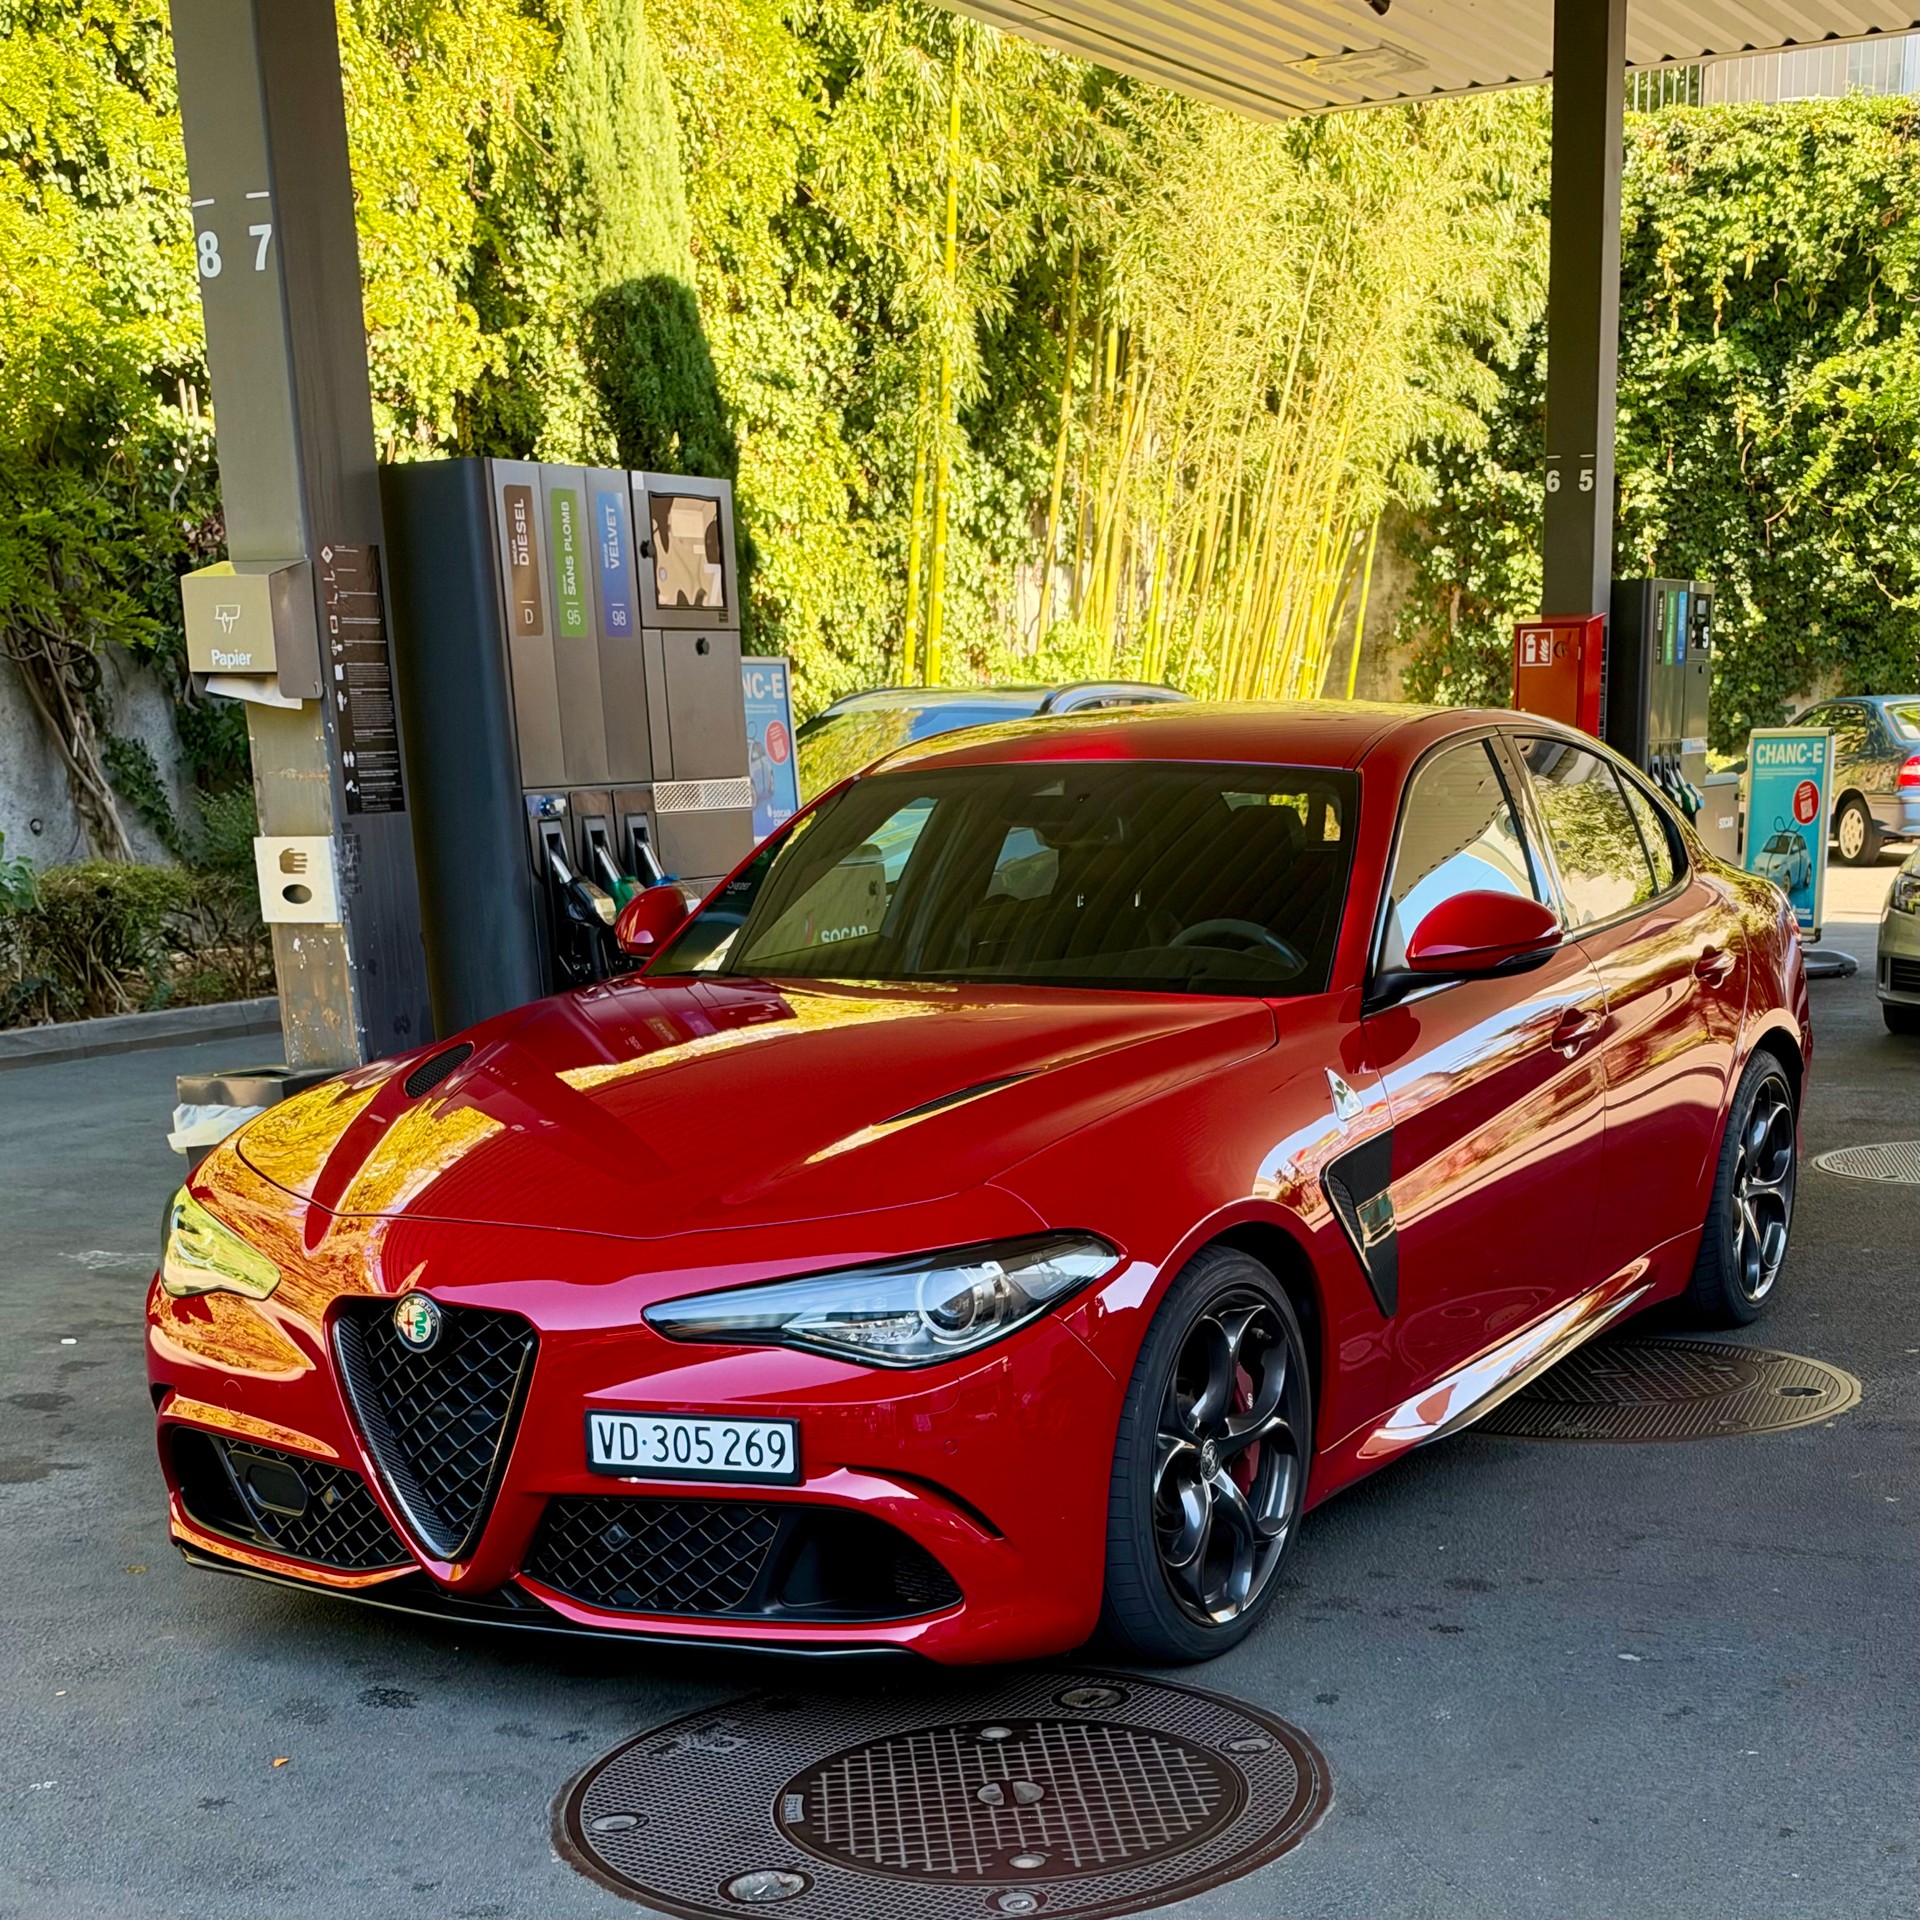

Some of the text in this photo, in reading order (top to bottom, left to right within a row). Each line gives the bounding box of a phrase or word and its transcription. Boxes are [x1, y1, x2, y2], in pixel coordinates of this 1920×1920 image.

[198, 224, 272, 278] 8 7
[1546, 469, 1593, 493] 6 5
[514, 498, 530, 566] DIESEL
[561, 501, 573, 552] PLOMB
[605, 505, 620, 569] VELVET
[565, 555, 577, 596] SANS
[703, 563, 722, 606] 7
[524, 608, 534, 624] D
[567, 609, 581, 625] 95
[612, 611, 627, 626] 98
[1702, 626, 1709, 649] 5
[210, 649, 252, 669] Papier
[1756, 742, 1824, 765] CHANC-E
